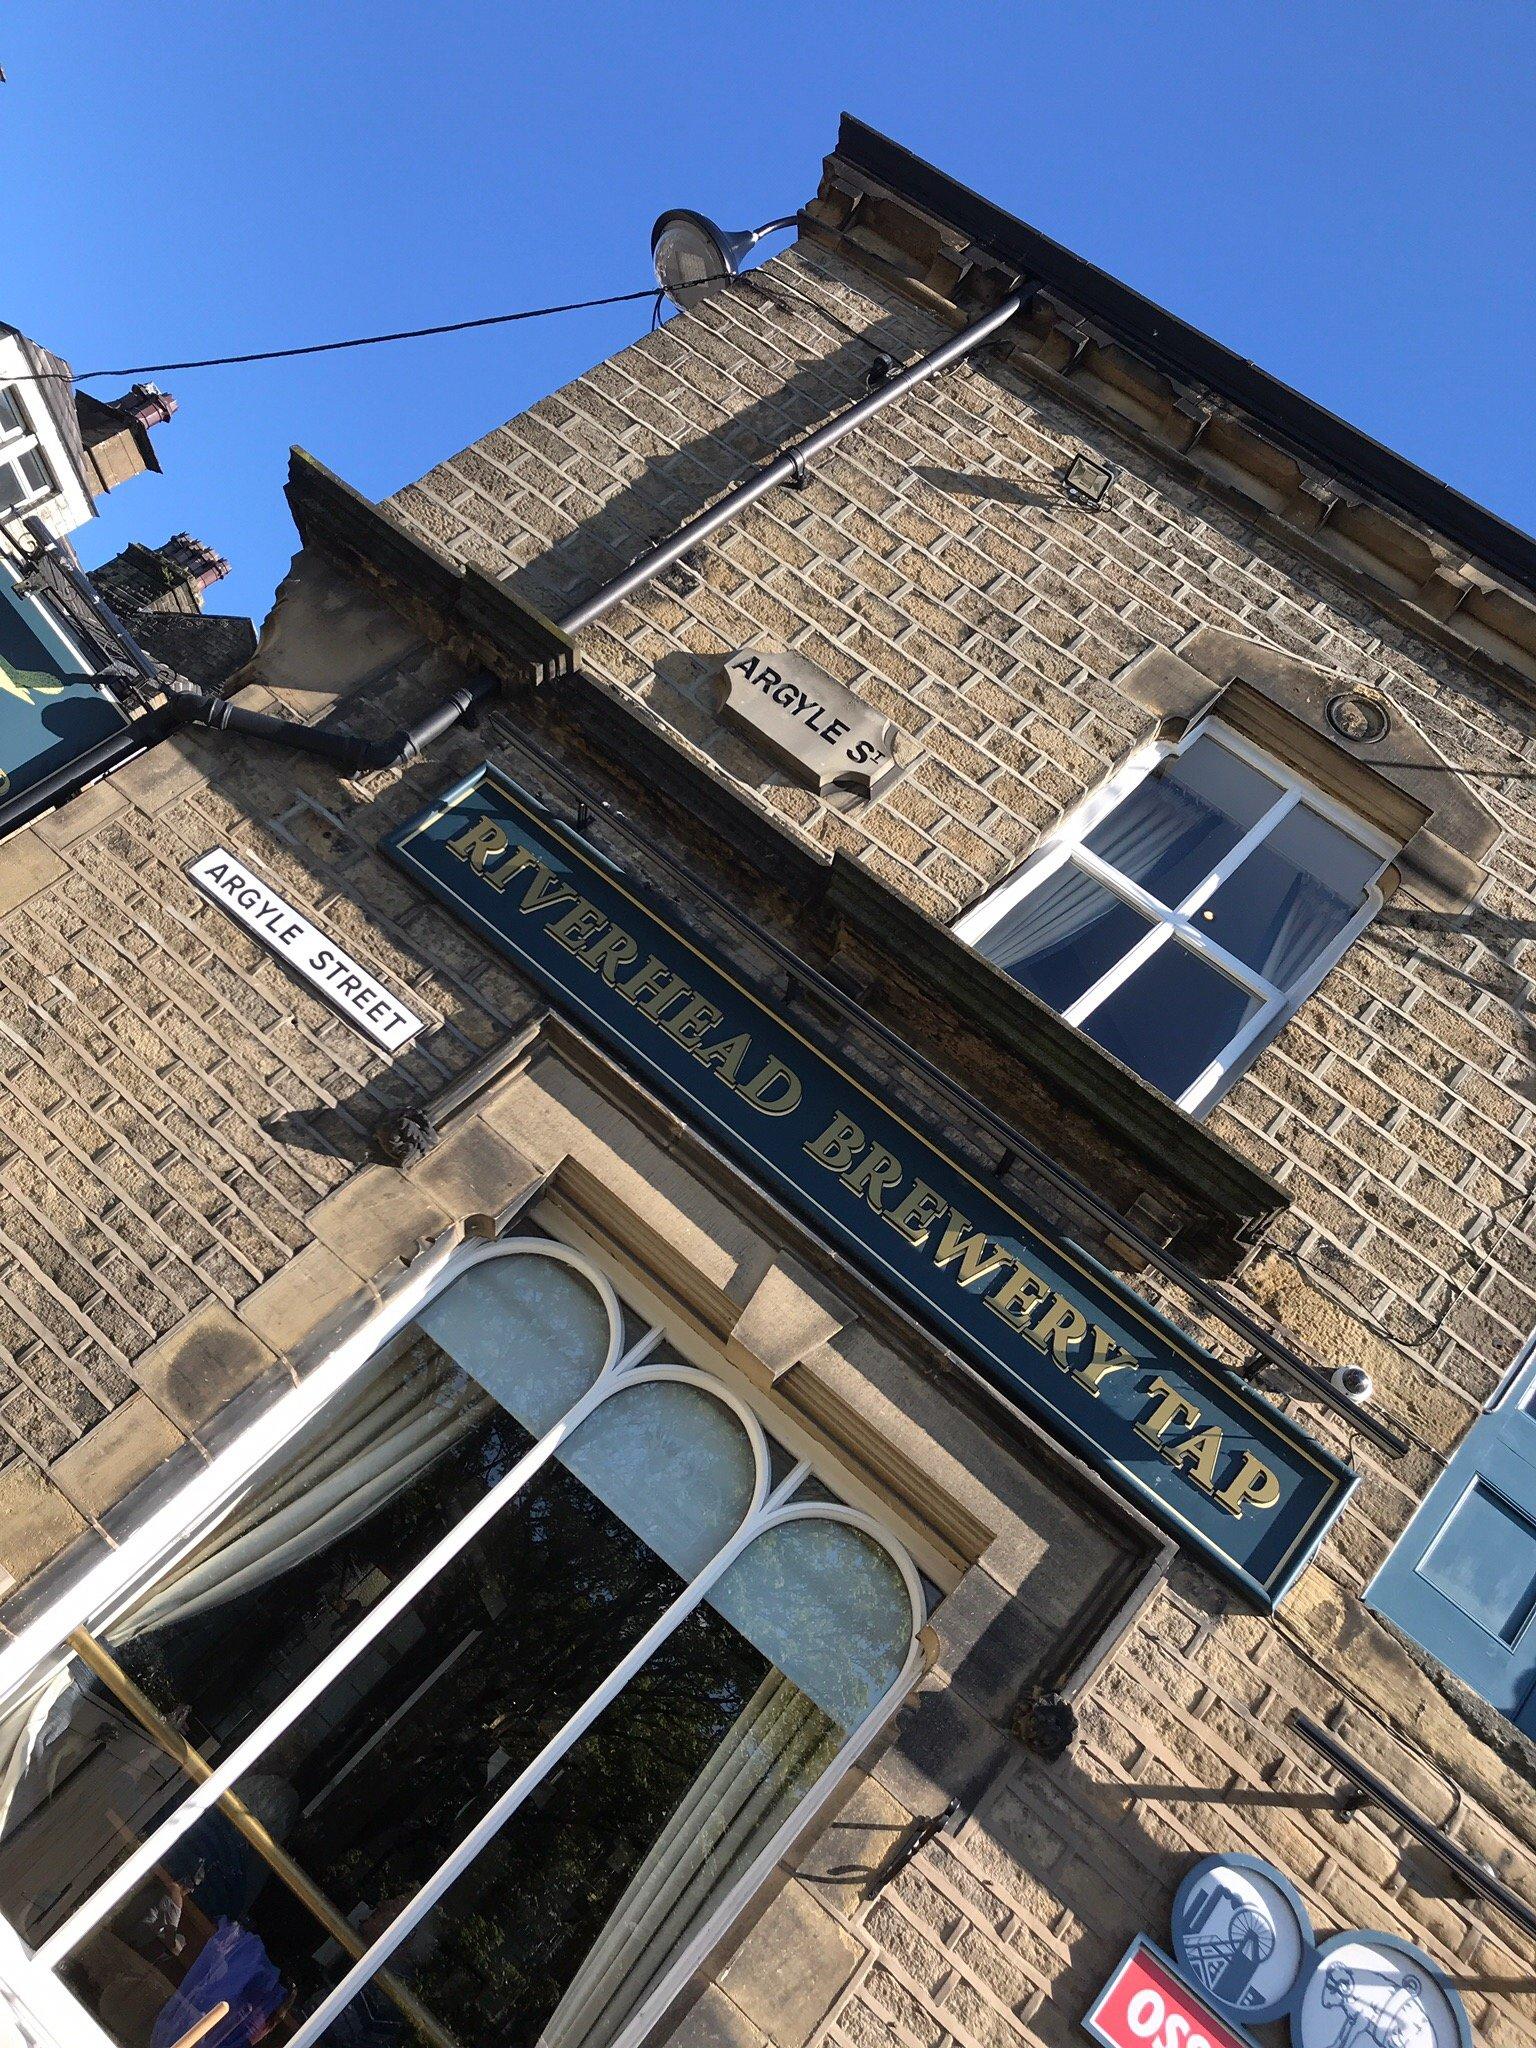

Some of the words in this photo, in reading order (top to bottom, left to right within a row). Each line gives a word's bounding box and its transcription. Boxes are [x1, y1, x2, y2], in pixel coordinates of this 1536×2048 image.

[731, 655, 851, 746] ARGYLE
[204, 863, 304, 946] ARGYLE
[309, 950, 408, 1032] STREET
[445, 815, 803, 1117] RIVERHEAD
[802, 1109, 1140, 1399] BREWERY
[1132, 1375, 1282, 1521] TAP
